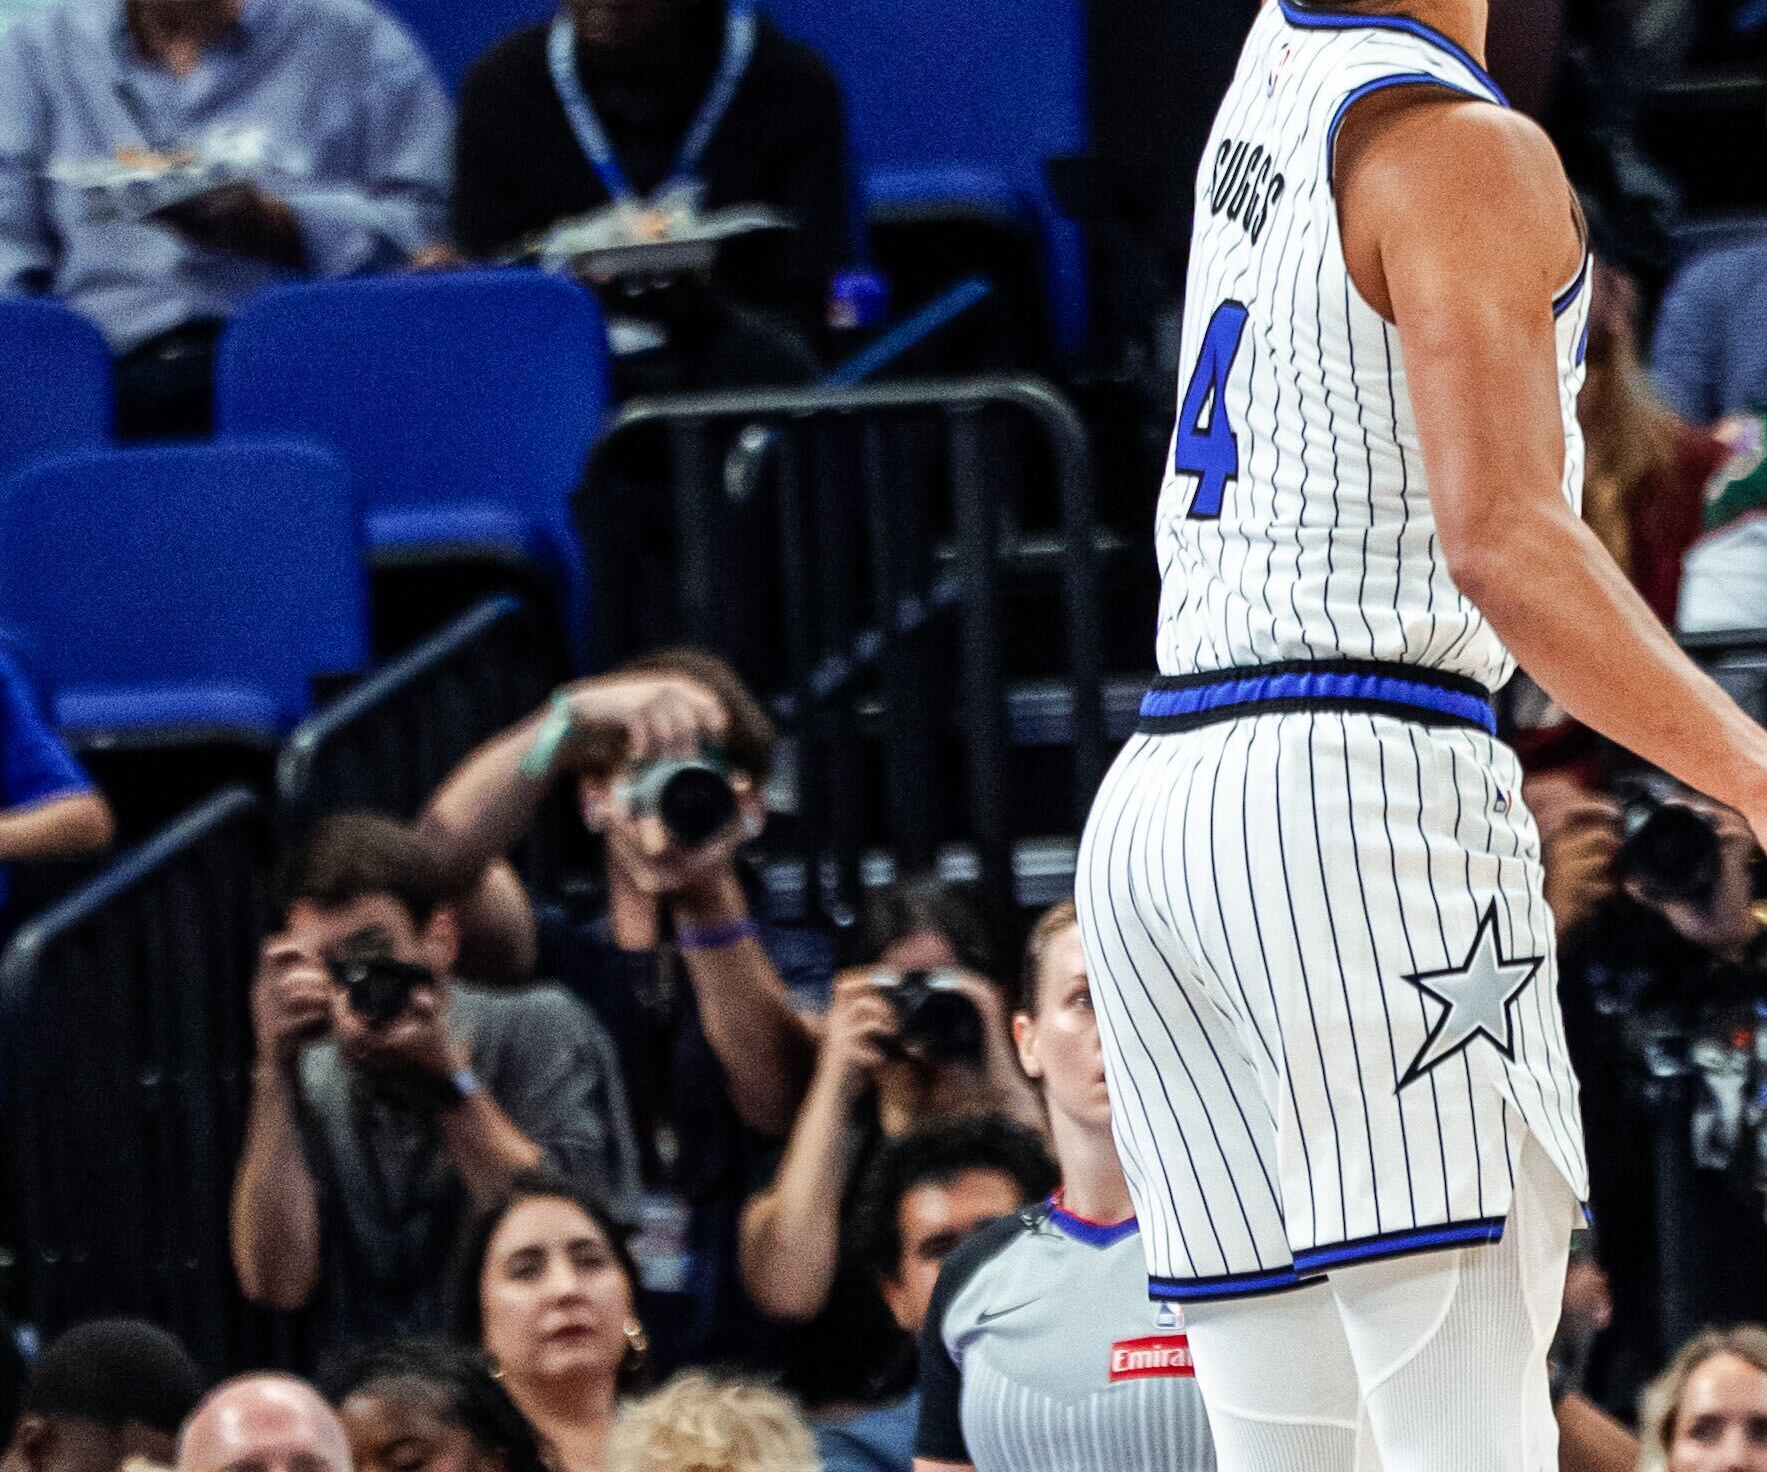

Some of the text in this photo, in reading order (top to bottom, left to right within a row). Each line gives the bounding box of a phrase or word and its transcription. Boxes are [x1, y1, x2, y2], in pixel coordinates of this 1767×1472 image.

[1211, 138, 1285, 247] SUGGS
[1175, 298, 1249, 521] 4
[1111, 1341, 1193, 1374] Emira
